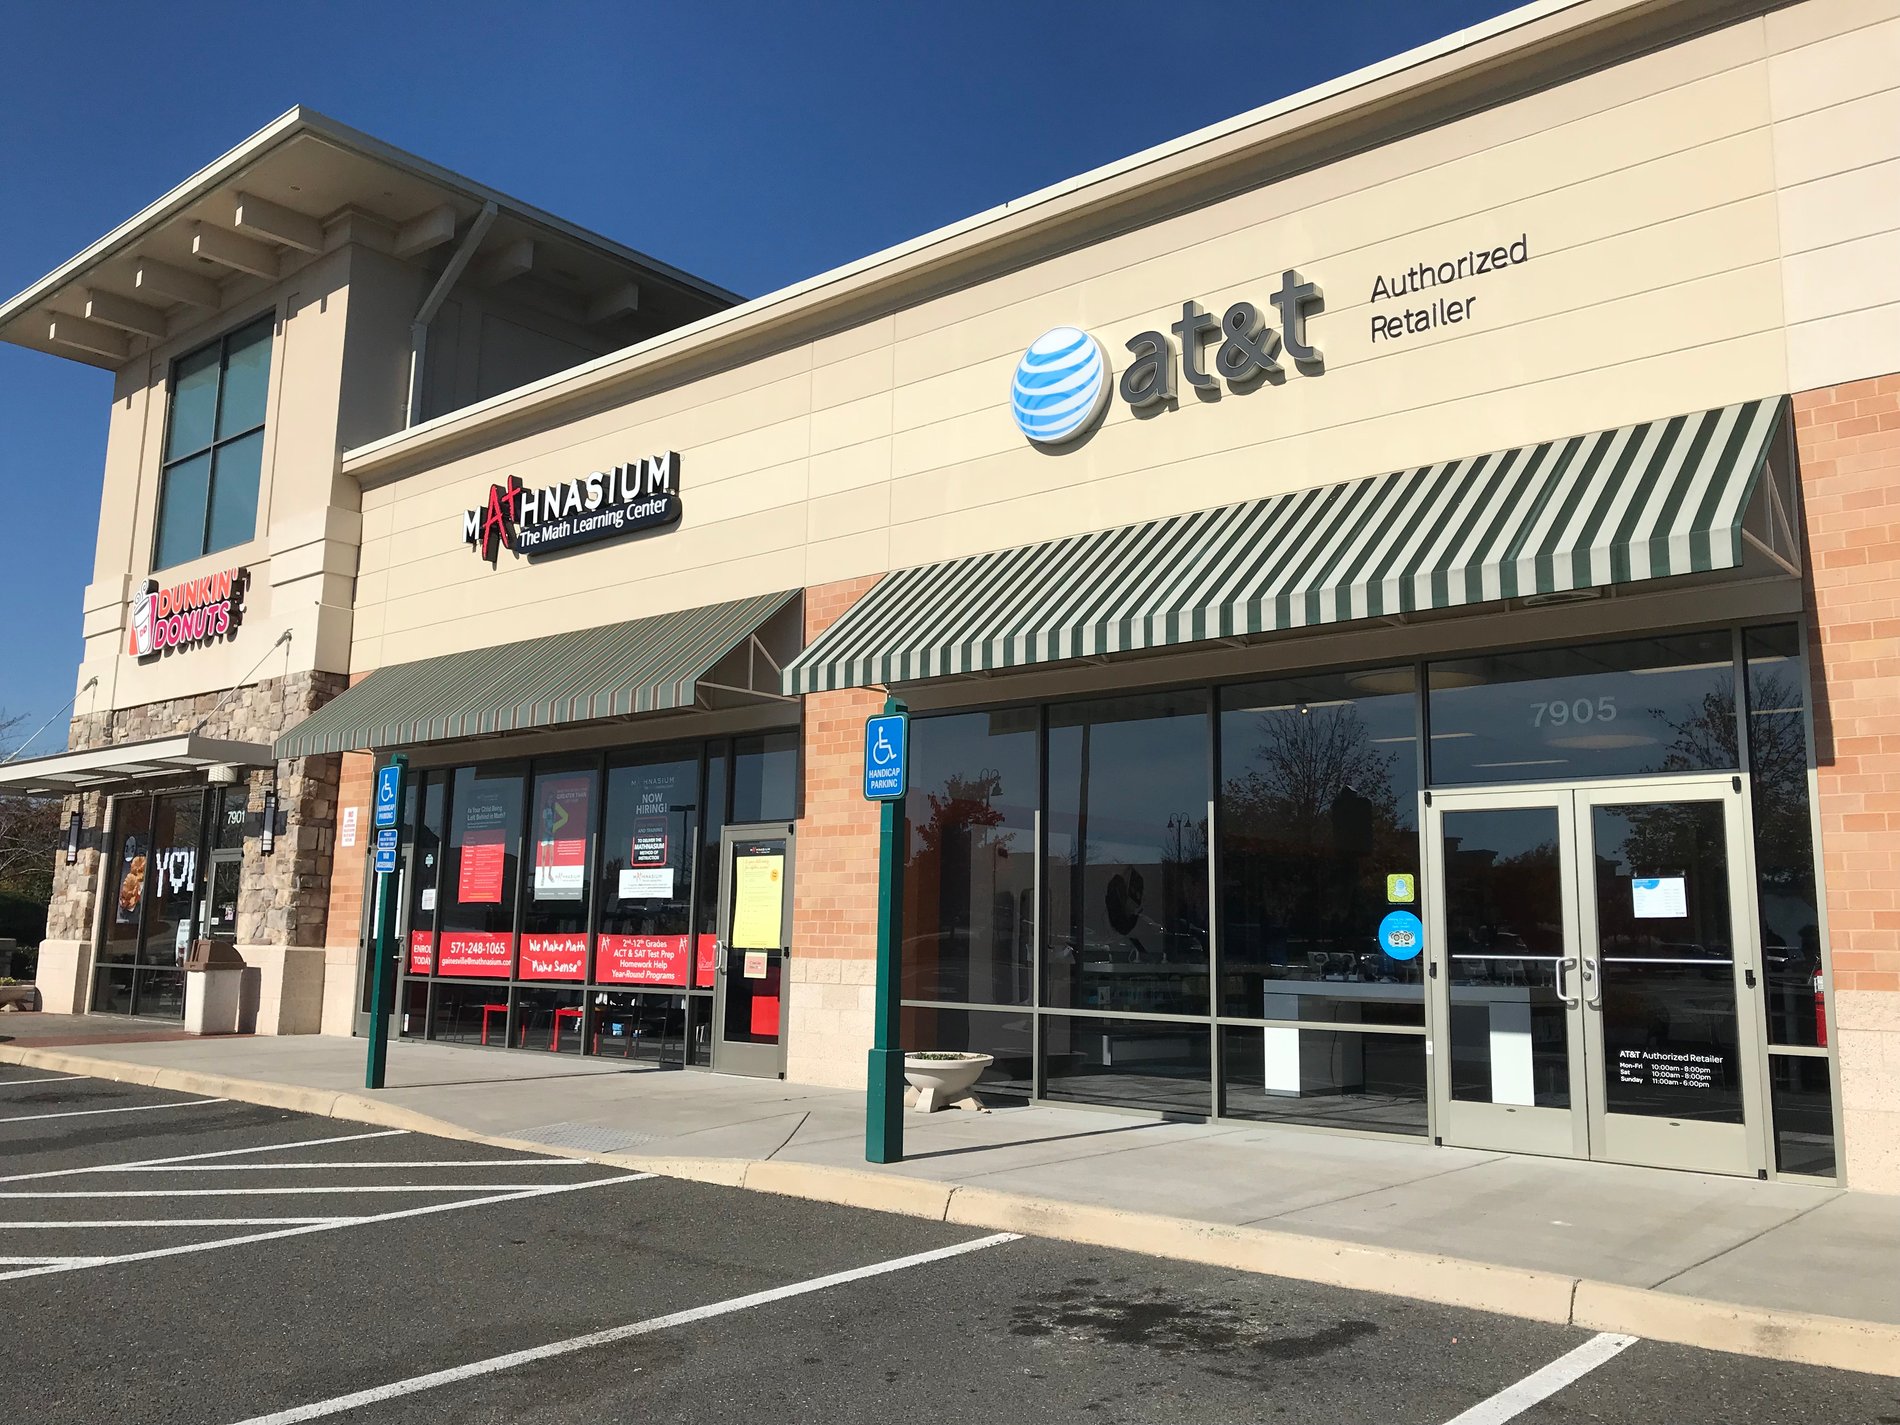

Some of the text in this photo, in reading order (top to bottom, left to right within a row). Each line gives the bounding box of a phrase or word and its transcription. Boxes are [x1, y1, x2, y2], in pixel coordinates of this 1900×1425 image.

[1370, 233, 1529, 303] Authorized
[1371, 294, 1476, 343] Retailer
[1119, 269, 1323, 412] at&t
[462, 450, 673, 561] MATHNASIUM
[520, 498, 668, 547] The Math Learning Center
[158, 567, 238, 619] DUNKIN'
[153, 600, 231, 650] DONUTS
[1530, 696, 1618, 729] 7905
[868, 767, 901, 779] HANDICAP
[631, 777, 675, 785] MHNASIUM
[870, 778, 898, 790] PARKING
[641, 792, 664, 804] NOW
[635, 803, 668, 815] HIRING!
[227, 811, 246, 825] 7901
[413, 944, 432, 954] ENROL
[450, 941, 506, 954] 571-248-1065
[529, 939, 586, 952] We Make Math
[645, 939, 668, 948] Grades
[613, 949, 675, 960] ACT & SAT Test Prep
[532, 960, 552, 973] Make
[620, 960, 668, 970] Homework Help
[612, 969, 675, 981] Year-Round Programs
[1619, 1050, 1724, 1064] AT&T Authorized Retailer
[1651, 1064, 1680, 1072] 10:00am
[1684, 1065, 1711, 1074] 8:00pm
[1620, 1076, 1644, 1084] Sunday
[1652, 1078, 1679, 1086] 11:00am
[1683, 1080, 1710, 1088] 6:00pm
[1652, 1071, 1680, 1079] 10:00am
[1684, 1073, 1712, 1081] 8:00pm
